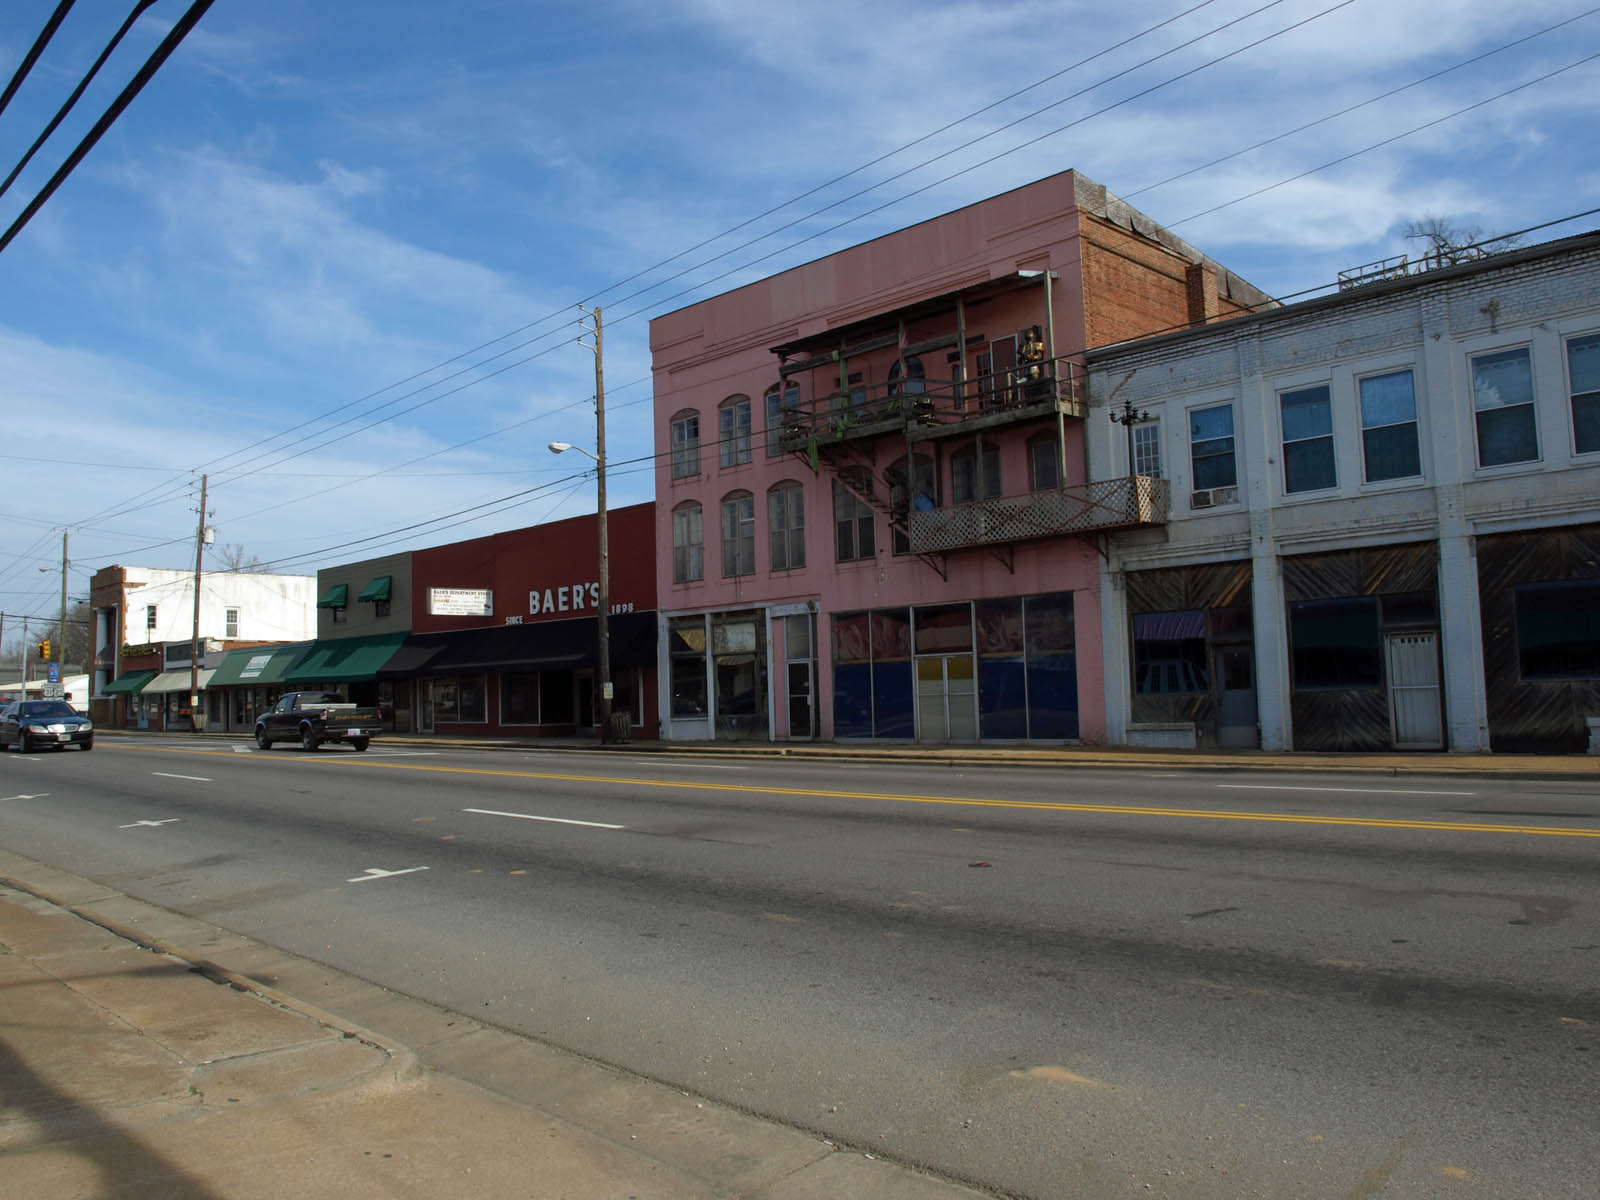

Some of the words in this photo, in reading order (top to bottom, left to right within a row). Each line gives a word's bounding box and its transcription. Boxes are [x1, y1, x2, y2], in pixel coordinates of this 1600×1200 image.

[529, 582, 600, 614] BAER'S
[505, 616, 523, 625] SINCE
[611, 603, 634, 615] 1898
